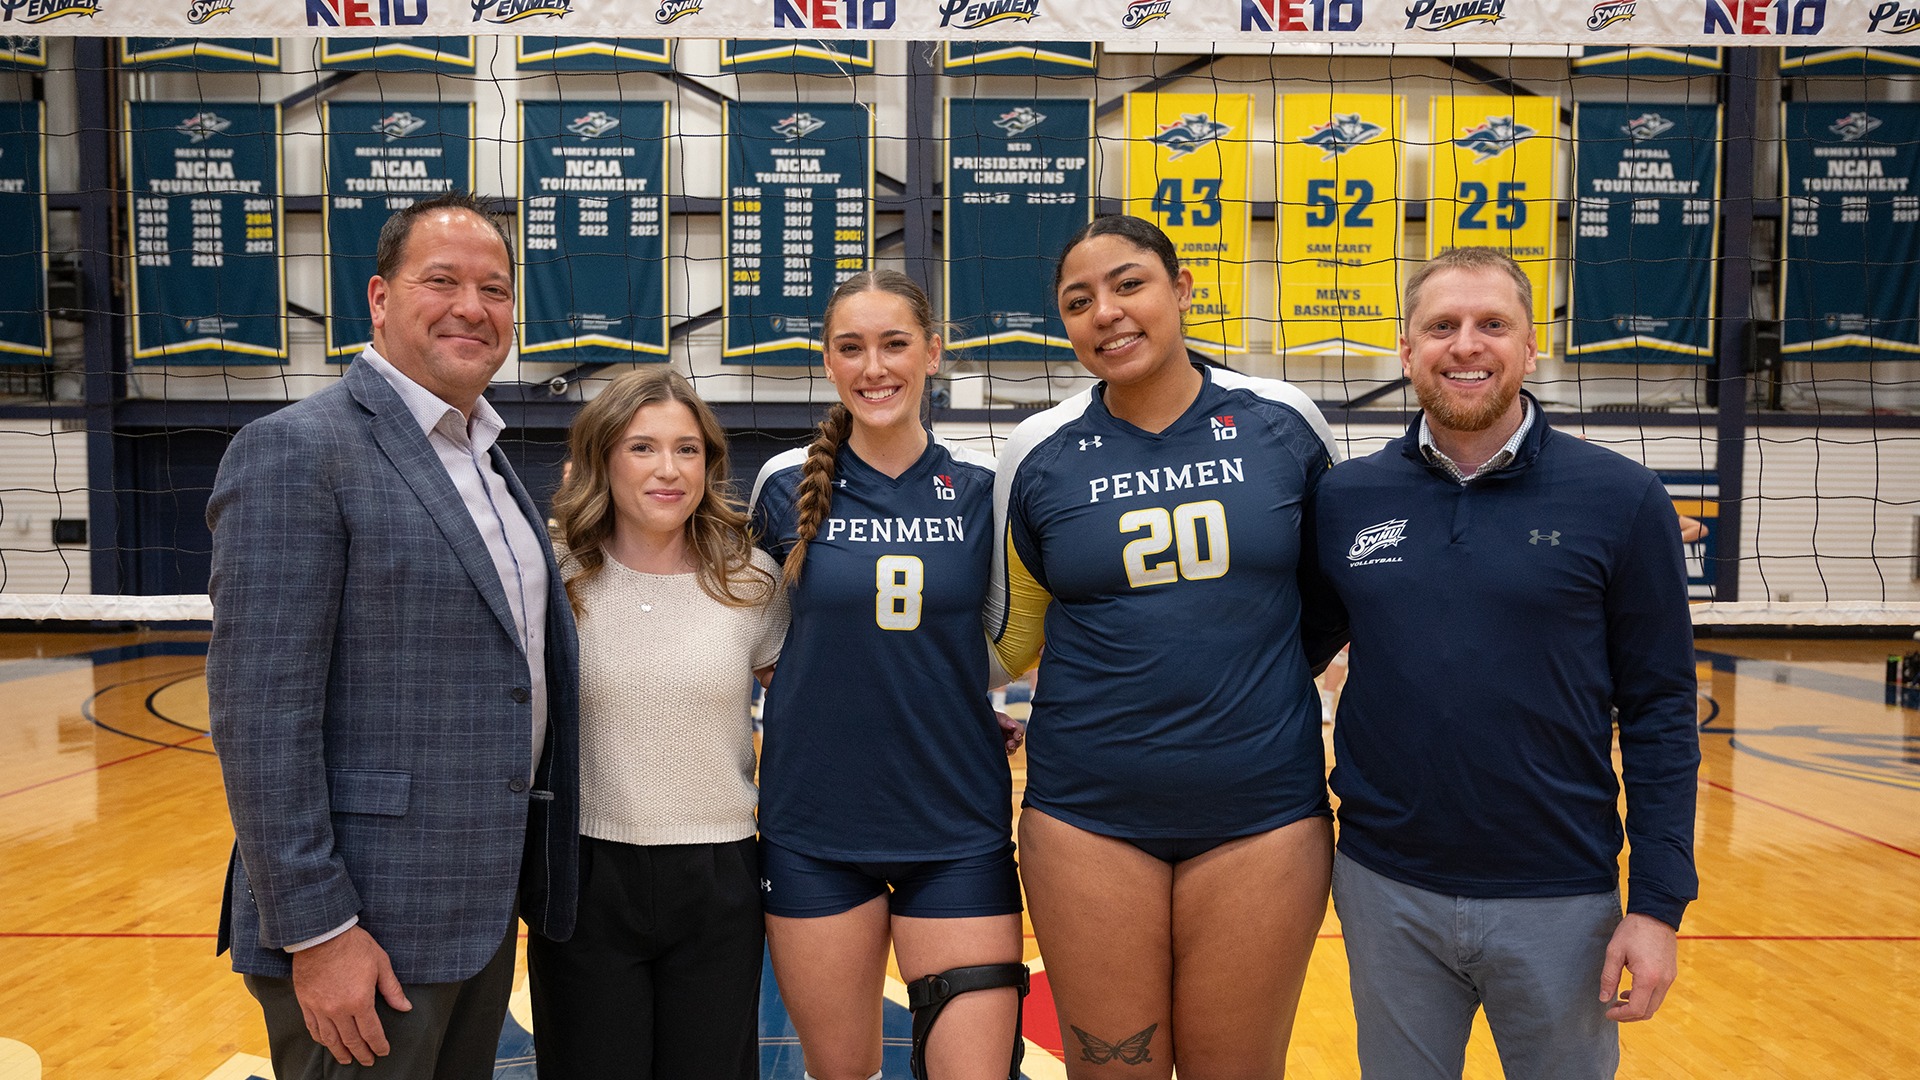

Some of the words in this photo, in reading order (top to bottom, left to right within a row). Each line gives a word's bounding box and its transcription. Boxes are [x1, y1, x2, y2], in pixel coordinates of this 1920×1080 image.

[773, 0, 896, 30] NE10
[1123, 2, 1169, 27] SNHU
[1241, 0, 1363, 32] NE10
[1587, 4, 1634, 29] SNHU
[1703, 0, 1826, 35] NE10
[1867, 2, 1920, 33] PEN
[388, 148, 404, 157] ICE
[406, 148, 443, 157] HOCKEY
[552, 148, 598, 157] WOMEN'S
[599, 148, 635, 157] SOCCER
[1007, 143, 1031, 151] NE10
[1814, 147, 1859, 157] WOMEN'S
[1623, 149, 1670, 159] SOFTBALL
[176, 161, 234, 179] NCAA
[370, 160, 427, 178] NCAA
[565, 160, 622, 177] NCAA
[775, 159, 820, 172] NCAA
[953, 157, 1052, 170] PRESIDENTS'
[1056, 157, 1086, 170] CUP
[1618, 161, 1674, 178] NCAA
[1827, 160, 1883, 177] NCAA
[540, 178, 647, 191] TOURNAMENT
[755, 173, 841, 184] TOURNAMENT
[974, 172, 1065, 184] CHAMPIONS
[1802, 178, 1909, 191] TOURNAMENT
[150, 180, 261, 192] TOURNAMENT
[345, 179, 453, 192] TOURNAMENT
[1593, 179, 1699, 193] TOURNAMENT
[631, 197, 658, 208] 2012
[836, 202, 863, 213] 1992
[1151, 178, 1223, 226] 43
[1306, 180, 1374, 228] 52
[1458, 181, 1527, 230] 25
[528, 210, 556, 222] 2017
[579, 211, 608, 222] 2018
[631, 211, 658, 222] 2019
[527, 223, 556, 236] 2021
[578, 224, 608, 236] 2022
[630, 224, 659, 236] 2023
[527, 238, 557, 250] 2024
[1181, 243, 1228, 252] JORDAN
[1307, 244, 1332, 253] SAM
[1335, 244, 1371, 253] CAREY
[836, 258, 863, 269] 2012
[733, 270, 760, 282] 2013
[836, 271, 856, 283] 201
[1316, 289, 1360, 300] MEN'S
[1294, 305, 1382, 316] BASKETBALL
[1210, 415, 1235, 428] NE
[1213, 427, 1237, 441] 10
[933, 474, 954, 488] NE
[1089, 457, 1245, 503] PENMEN
[935, 486, 956, 500] 10
[826, 516, 965, 543] PENMEN
[1119, 499, 1230, 588] 20
[1349, 523, 1404, 557] SNHU
[1350, 556, 1403, 568] VOLLEYBALL
[876, 555, 923, 631] 8
